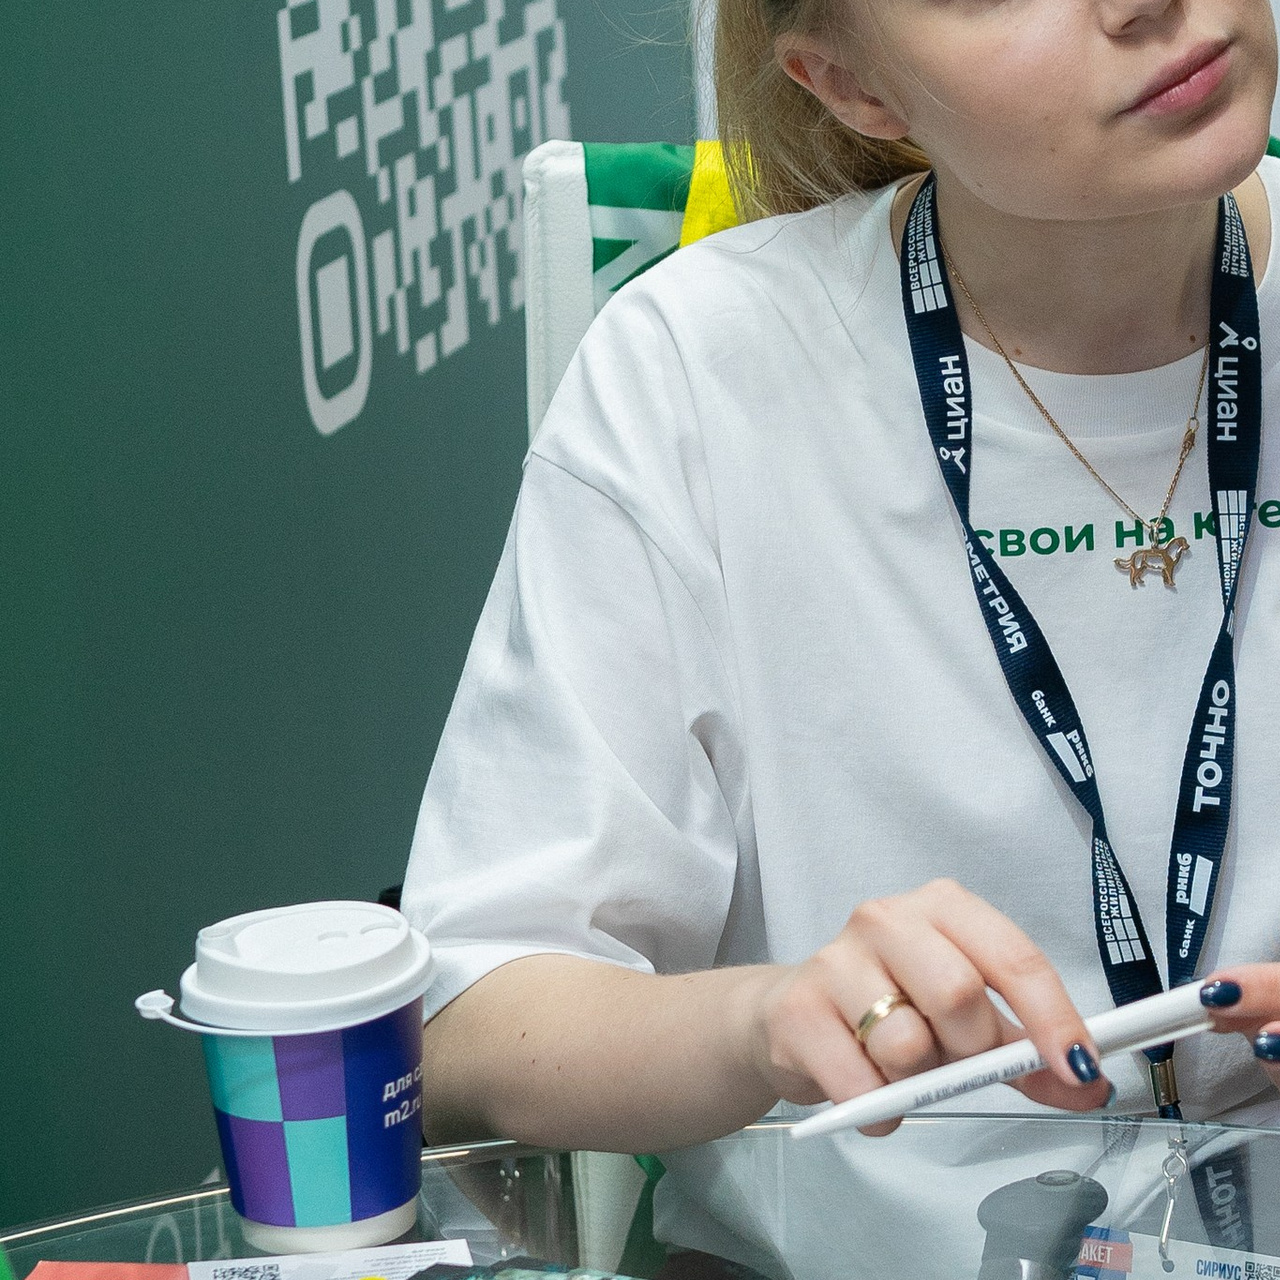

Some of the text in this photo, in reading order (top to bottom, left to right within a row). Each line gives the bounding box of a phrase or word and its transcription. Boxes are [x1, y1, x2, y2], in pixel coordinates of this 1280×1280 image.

[1221, 217, 1232, 274] КОНГРЕСС
[939, 354, 969, 441] циан
[1215, 357, 1238, 441] циан
[972, 523, 1094, 559] свои
[1115, 514, 1173, 549] на
[1031, 689, 1057, 728] банк
[1066, 729, 1094, 778] рнкб
[1193, 679, 1230, 813] ТОЧНО
[1103, 841, 1126, 894] КОНГРЕСС
[1176, 852, 1193, 905] рнкб
[1178, 919, 1196, 958] банк
[383, 1073, 413, 1102] для
[1196, 1258, 1242, 1280] СИРИУС
